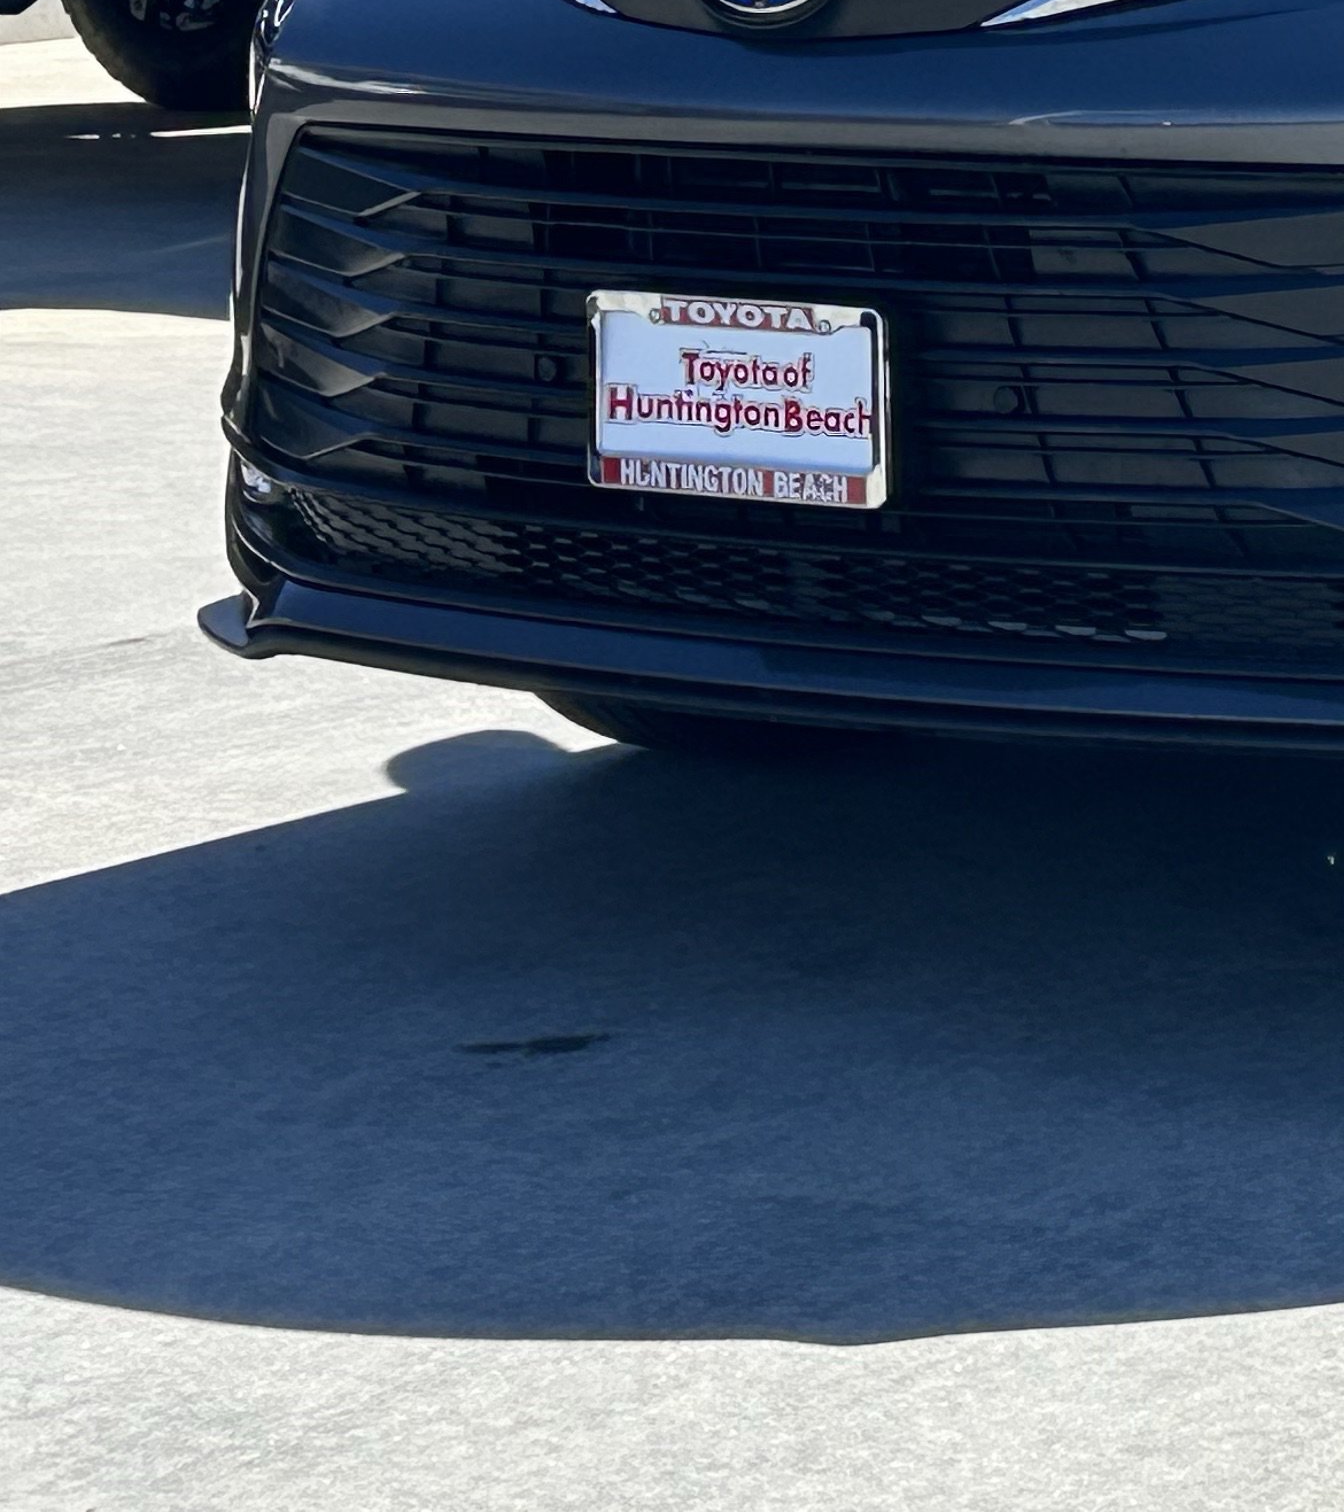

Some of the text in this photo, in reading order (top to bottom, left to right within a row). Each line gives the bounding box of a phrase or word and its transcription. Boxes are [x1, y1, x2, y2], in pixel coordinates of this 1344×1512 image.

[664, 299, 811, 330] TOYOTA
[680, 350, 812, 390] Toyota of
[607, 385, 781, 433] Huntington
[620, 458, 848, 504] HUNTINGTON BEACH
